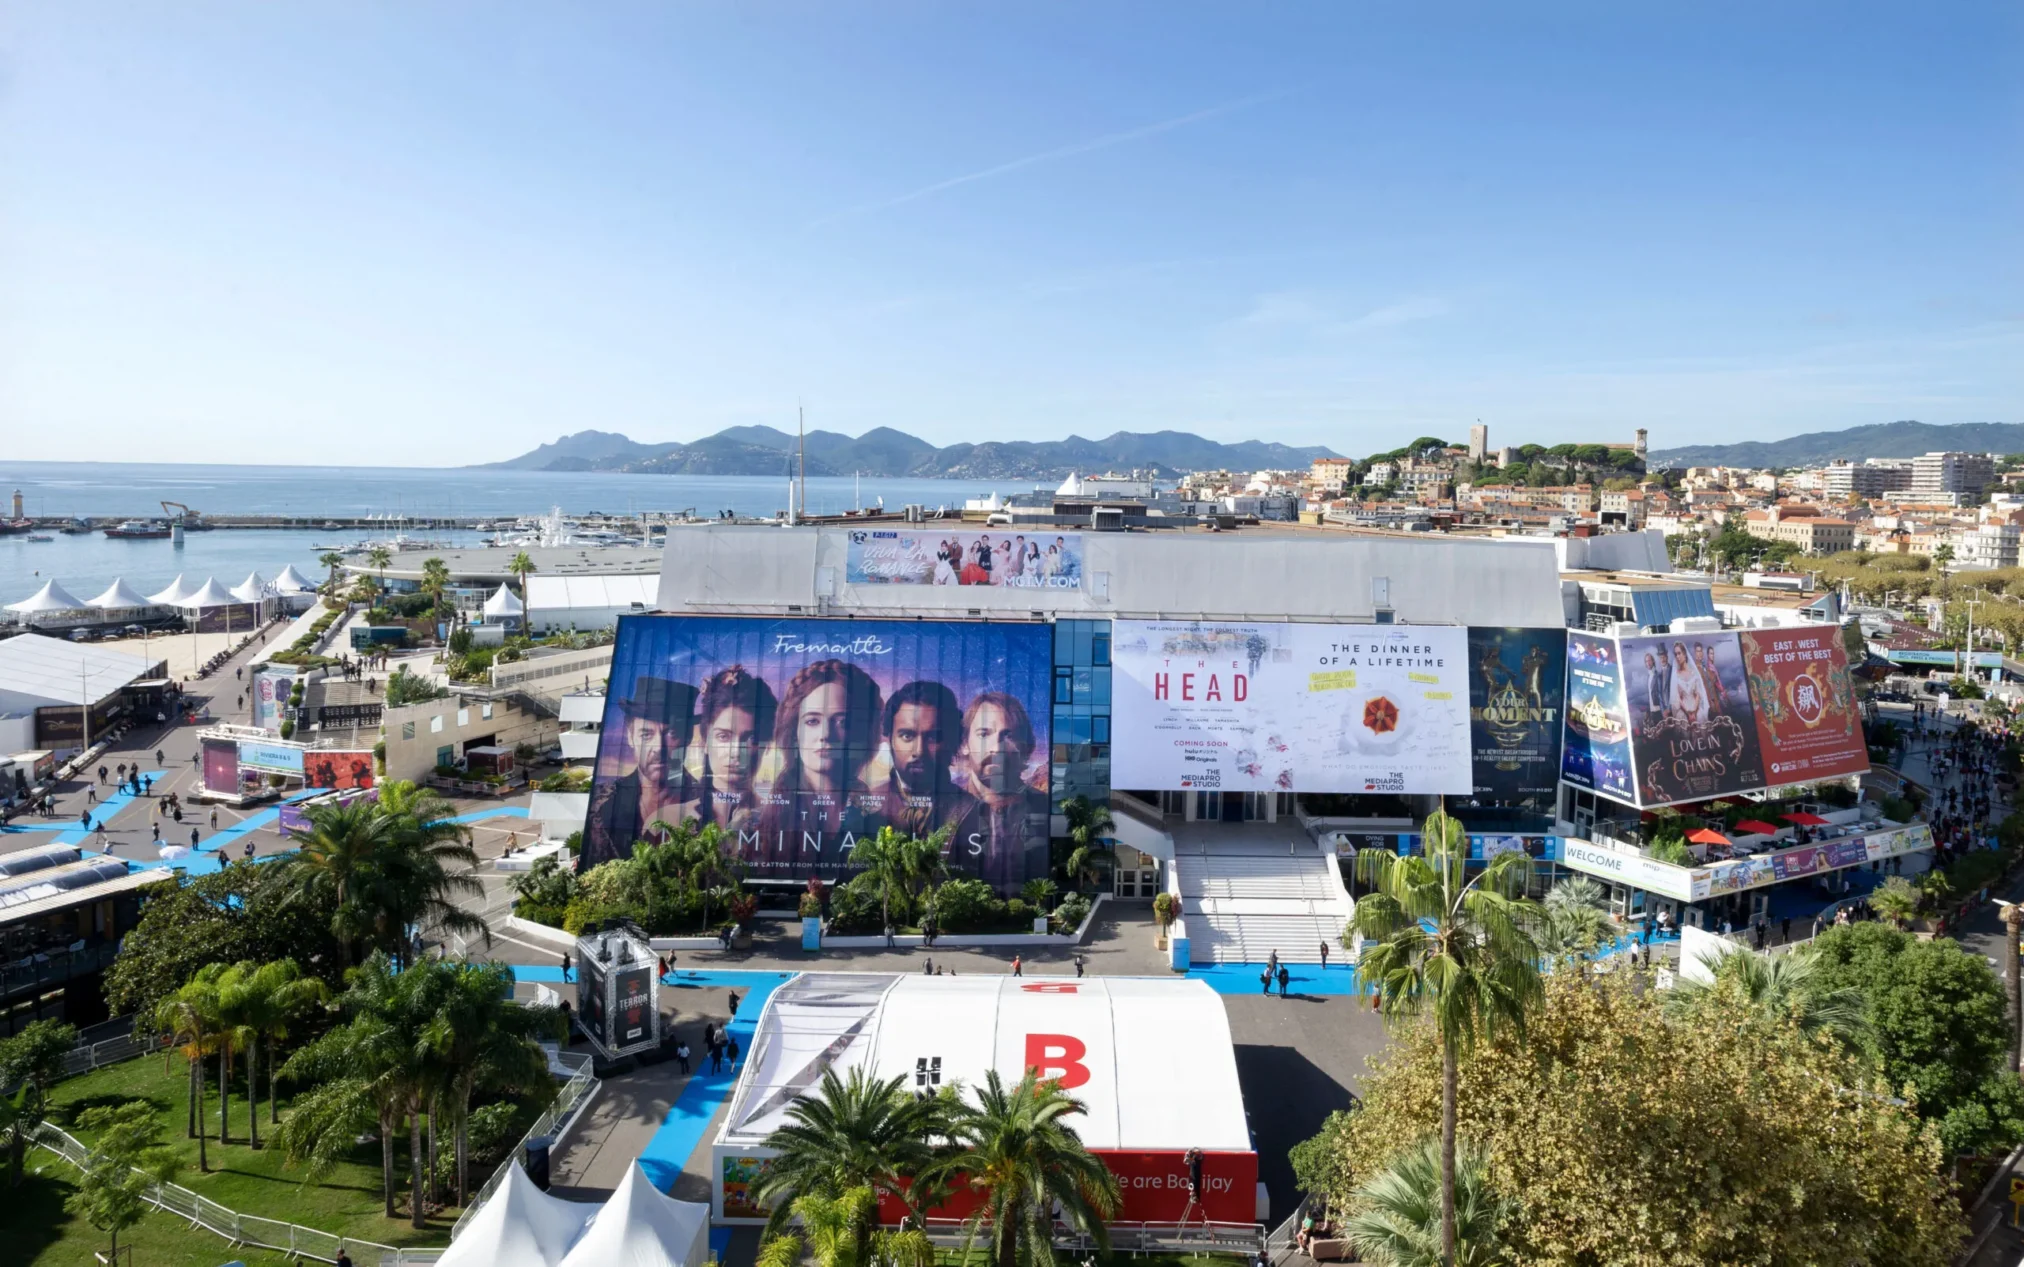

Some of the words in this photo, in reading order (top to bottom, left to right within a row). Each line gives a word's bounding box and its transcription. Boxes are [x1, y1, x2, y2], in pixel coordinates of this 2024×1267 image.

[904, 545, 926, 560] LA
[774, 634, 892, 654] Fremantle
[1331, 644, 1360, 652] THE
[1371, 645, 1431, 654] DINNER
[1773, 641, 1793, 651] EAST
[1797, 639, 1819, 649] WEST
[1164, 660, 1238, 668] THE
[1349, 658, 1358, 666] A
[1368, 658, 1444, 667] LIFETIME
[1764, 654, 1783, 664] BEST
[1785, 653, 1795, 662] OF
[1798, 652, 1812, 660] THE
[1814, 650, 1832, 659] BEST
[1155, 673, 1247, 701] HEAD
[1496, 698, 1526, 707] YOUR
[1471, 707, 1557, 722] MOMENT
[44, 720, 82, 732] Disney
[1670, 737, 1708, 757] LOVE
[1709, 733, 1721, 749] IN
[1673, 755, 1726, 781] CHAINS
[801, 811, 848, 821] THE
[1567, 847, 1622, 871] WELCOME
[619, 993, 648, 1009] TERROR
[1023, 1033, 1091, 1094] B
[1133, 1176, 1164, 1189] are
[1167, 1173, 1233, 1193] Baijay
